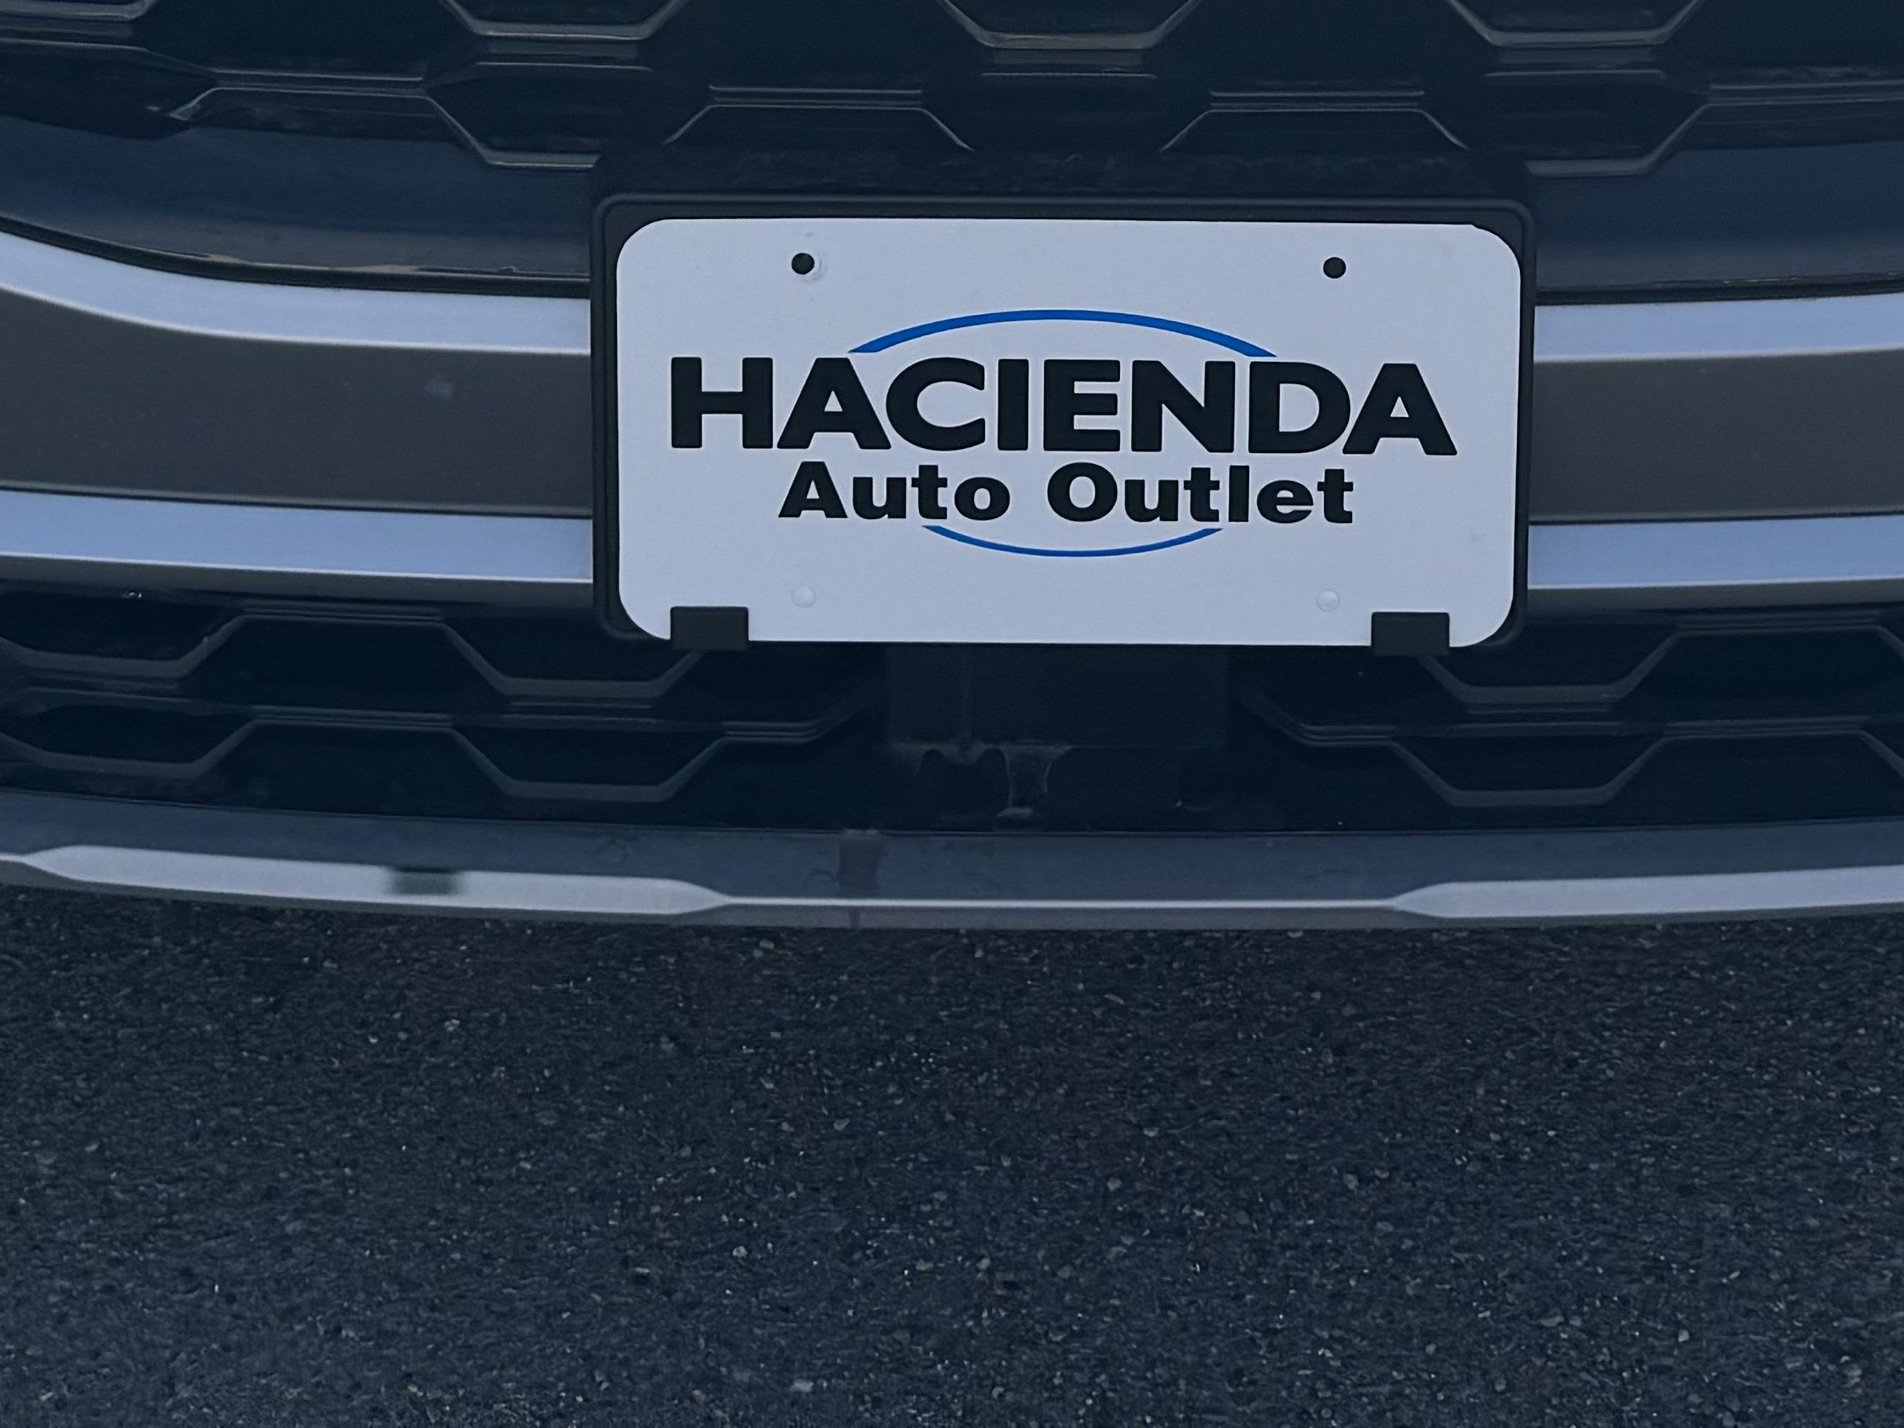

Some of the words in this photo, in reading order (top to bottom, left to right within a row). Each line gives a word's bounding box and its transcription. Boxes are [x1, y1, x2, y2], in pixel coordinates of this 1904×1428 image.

[670, 356, 1458, 456] HACIENDA
[778, 461, 1011, 521] Auto
[1047, 462, 1354, 524] Outlet
